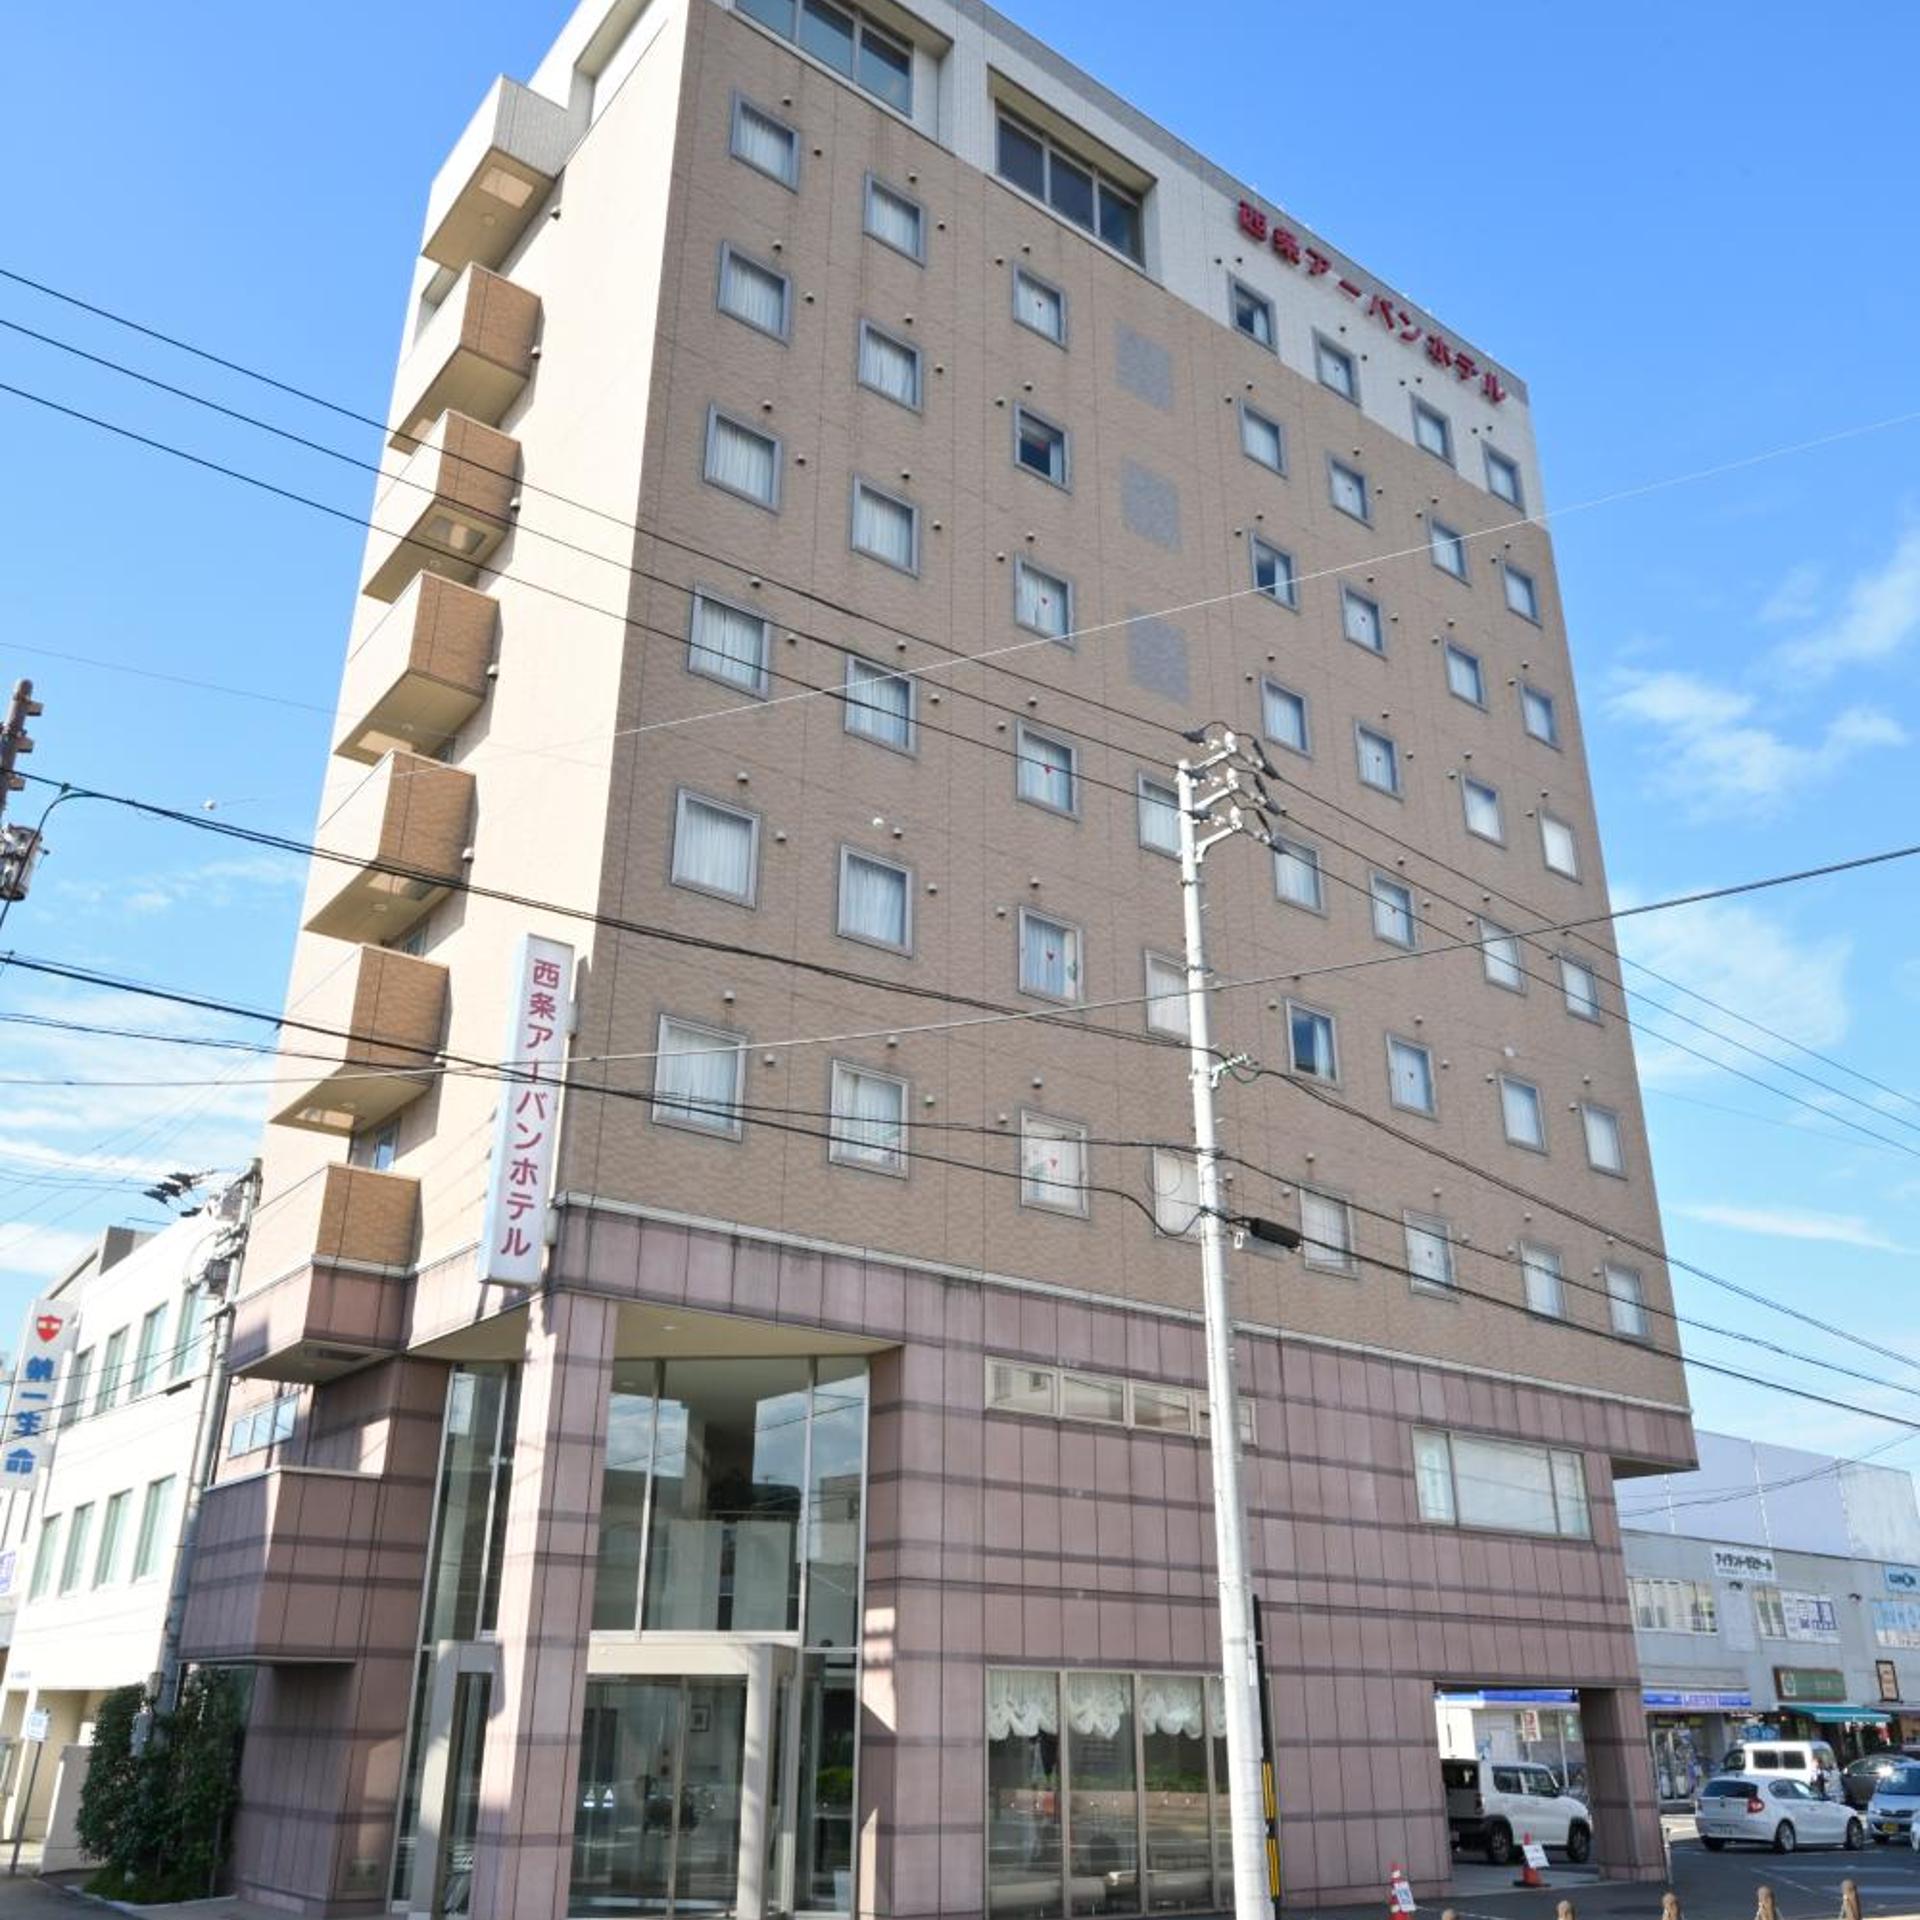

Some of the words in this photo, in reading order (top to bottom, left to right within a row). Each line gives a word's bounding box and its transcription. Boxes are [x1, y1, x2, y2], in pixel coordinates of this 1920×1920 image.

[1238, 199, 1506, 404] 西条アーバンホテル
[501, 957, 562, 1258] 西条アーバンホテル
